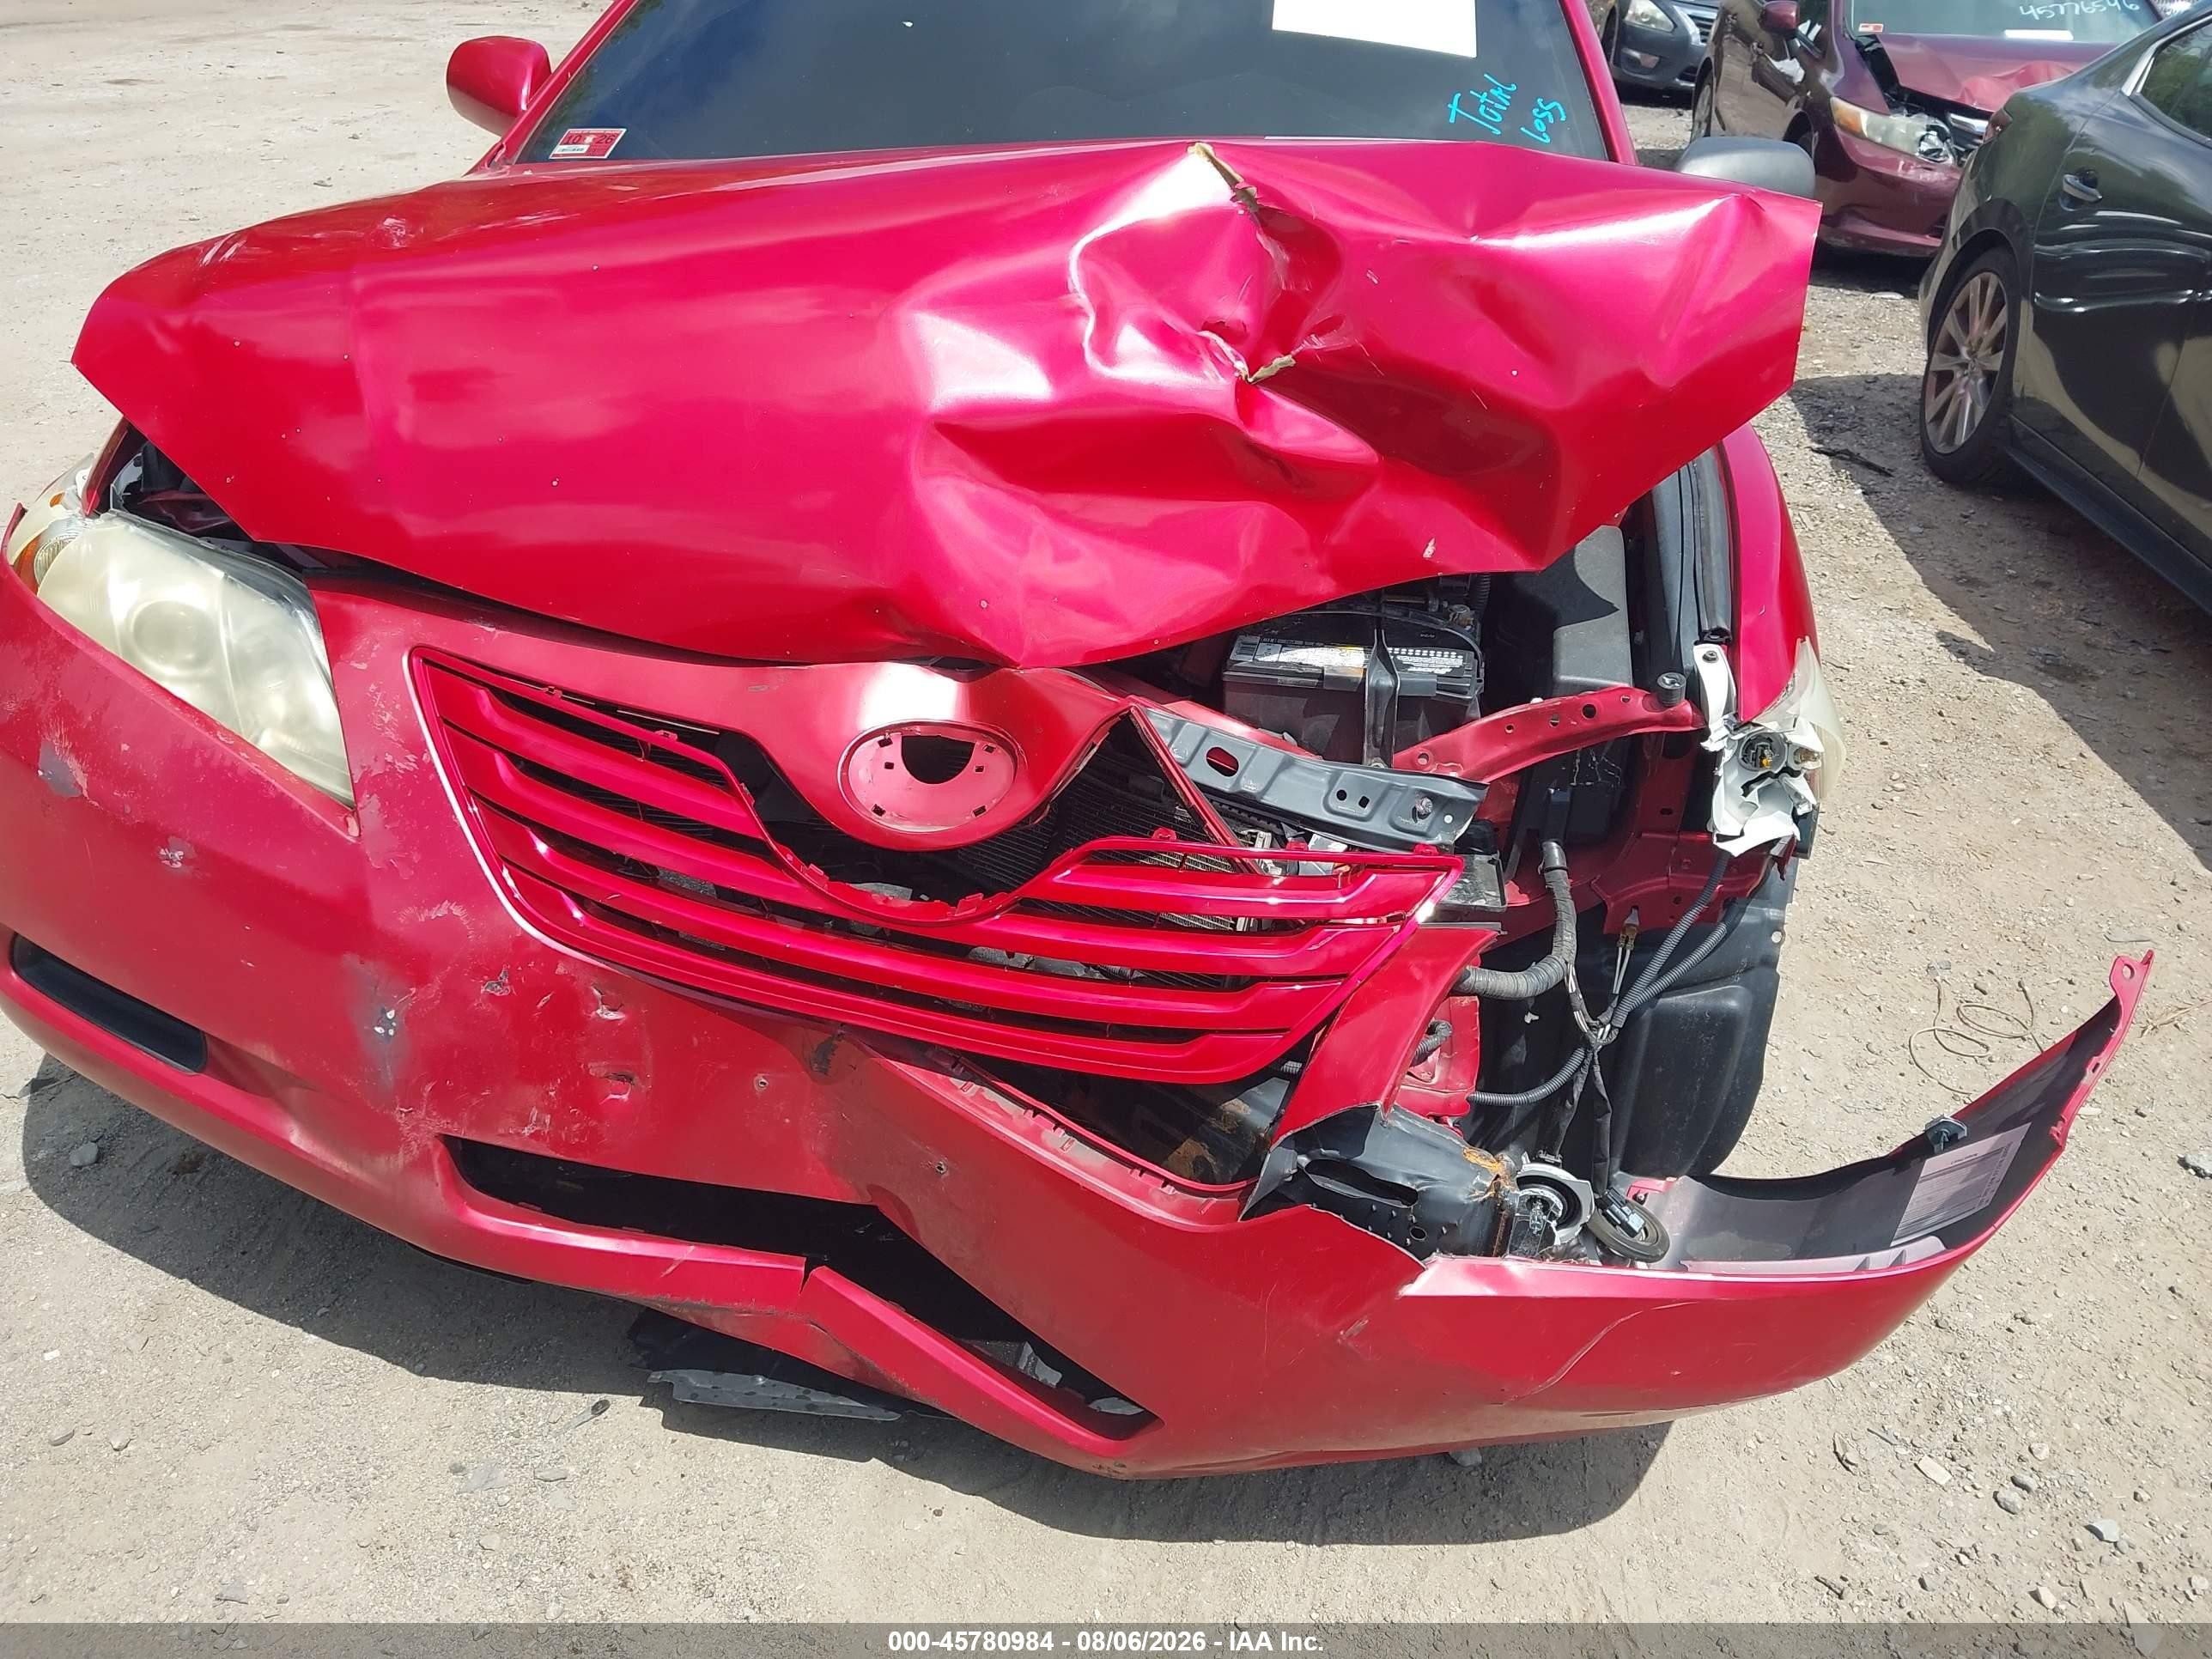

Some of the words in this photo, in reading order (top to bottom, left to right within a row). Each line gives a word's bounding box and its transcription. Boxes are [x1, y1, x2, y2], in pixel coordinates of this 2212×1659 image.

[1448, 73, 1517, 135] Total
[563, 135, 582, 145] 10
[596, 134, 616, 144] 26
